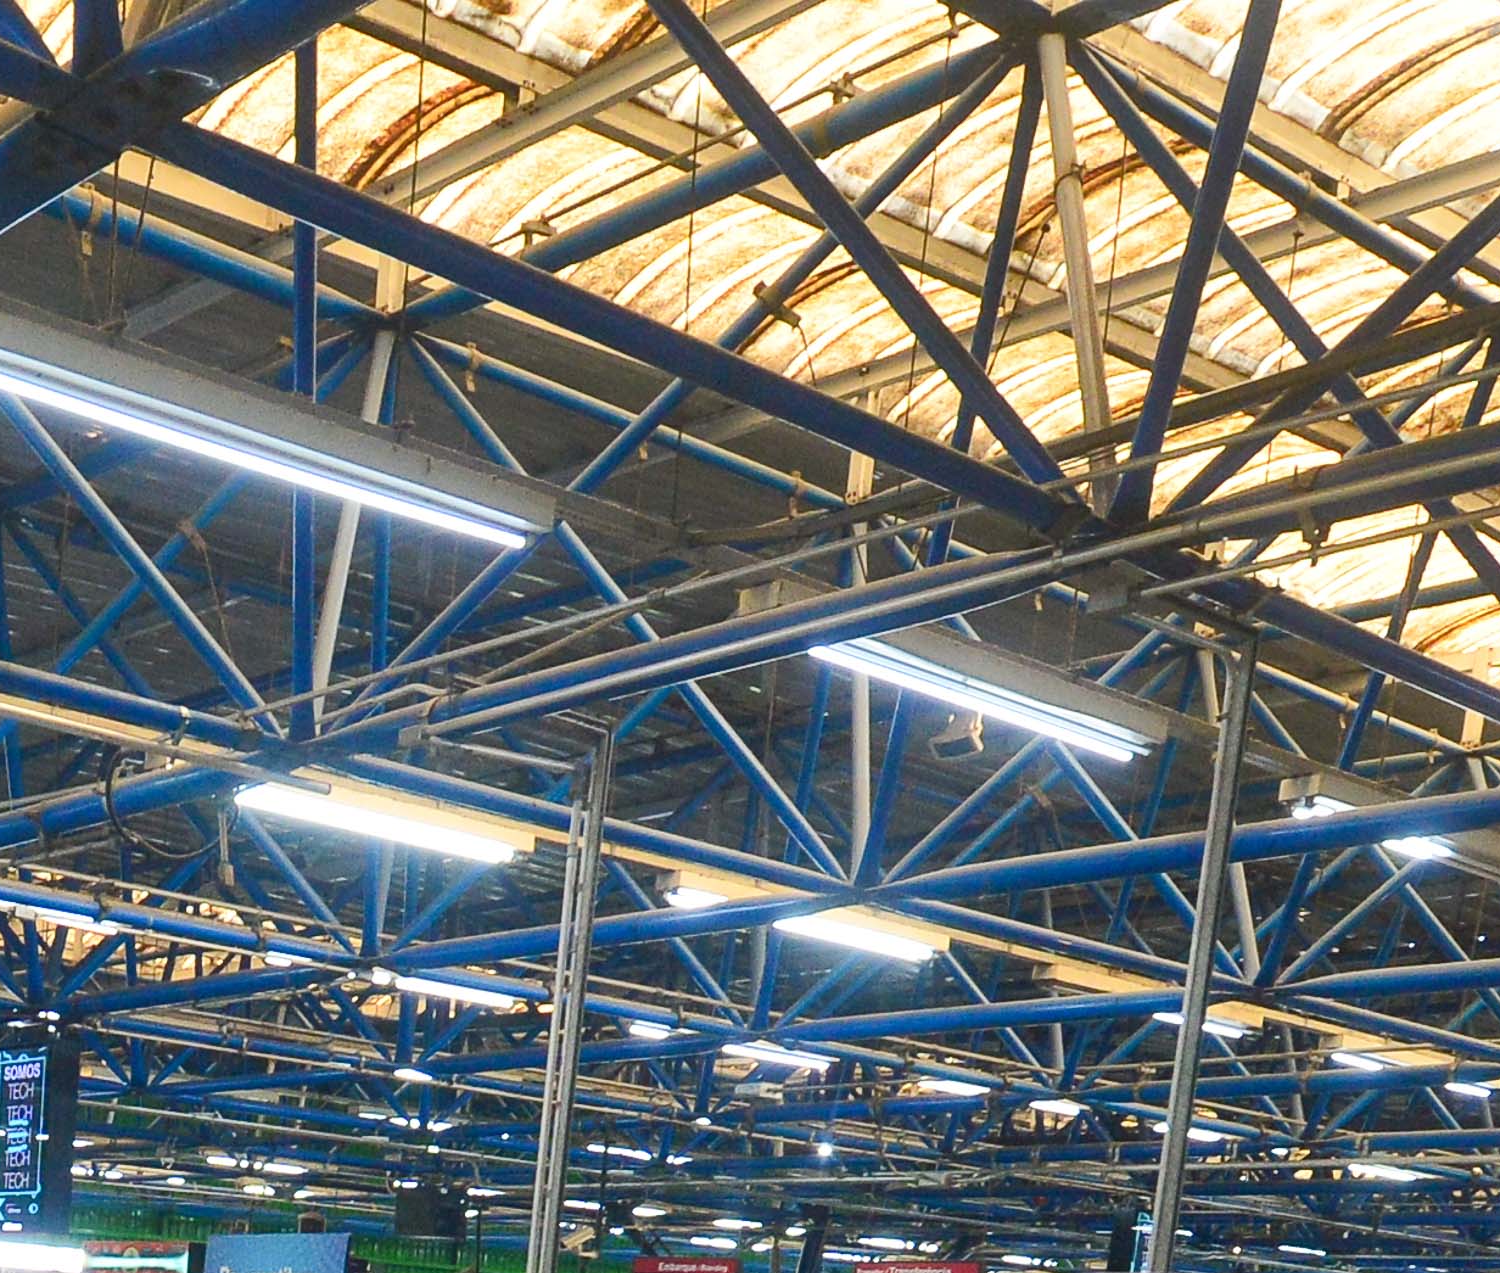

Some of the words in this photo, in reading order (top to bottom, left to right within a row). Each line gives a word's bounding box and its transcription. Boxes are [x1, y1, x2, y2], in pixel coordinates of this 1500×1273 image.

[4, 1063, 41, 1081] SOMOS
[8, 1082, 35, 1100] TECH
[7, 1105, 33, 1122] TECH
[5, 1150, 31, 1168] TECH
[4, 1172, 29, 1190] TECH
